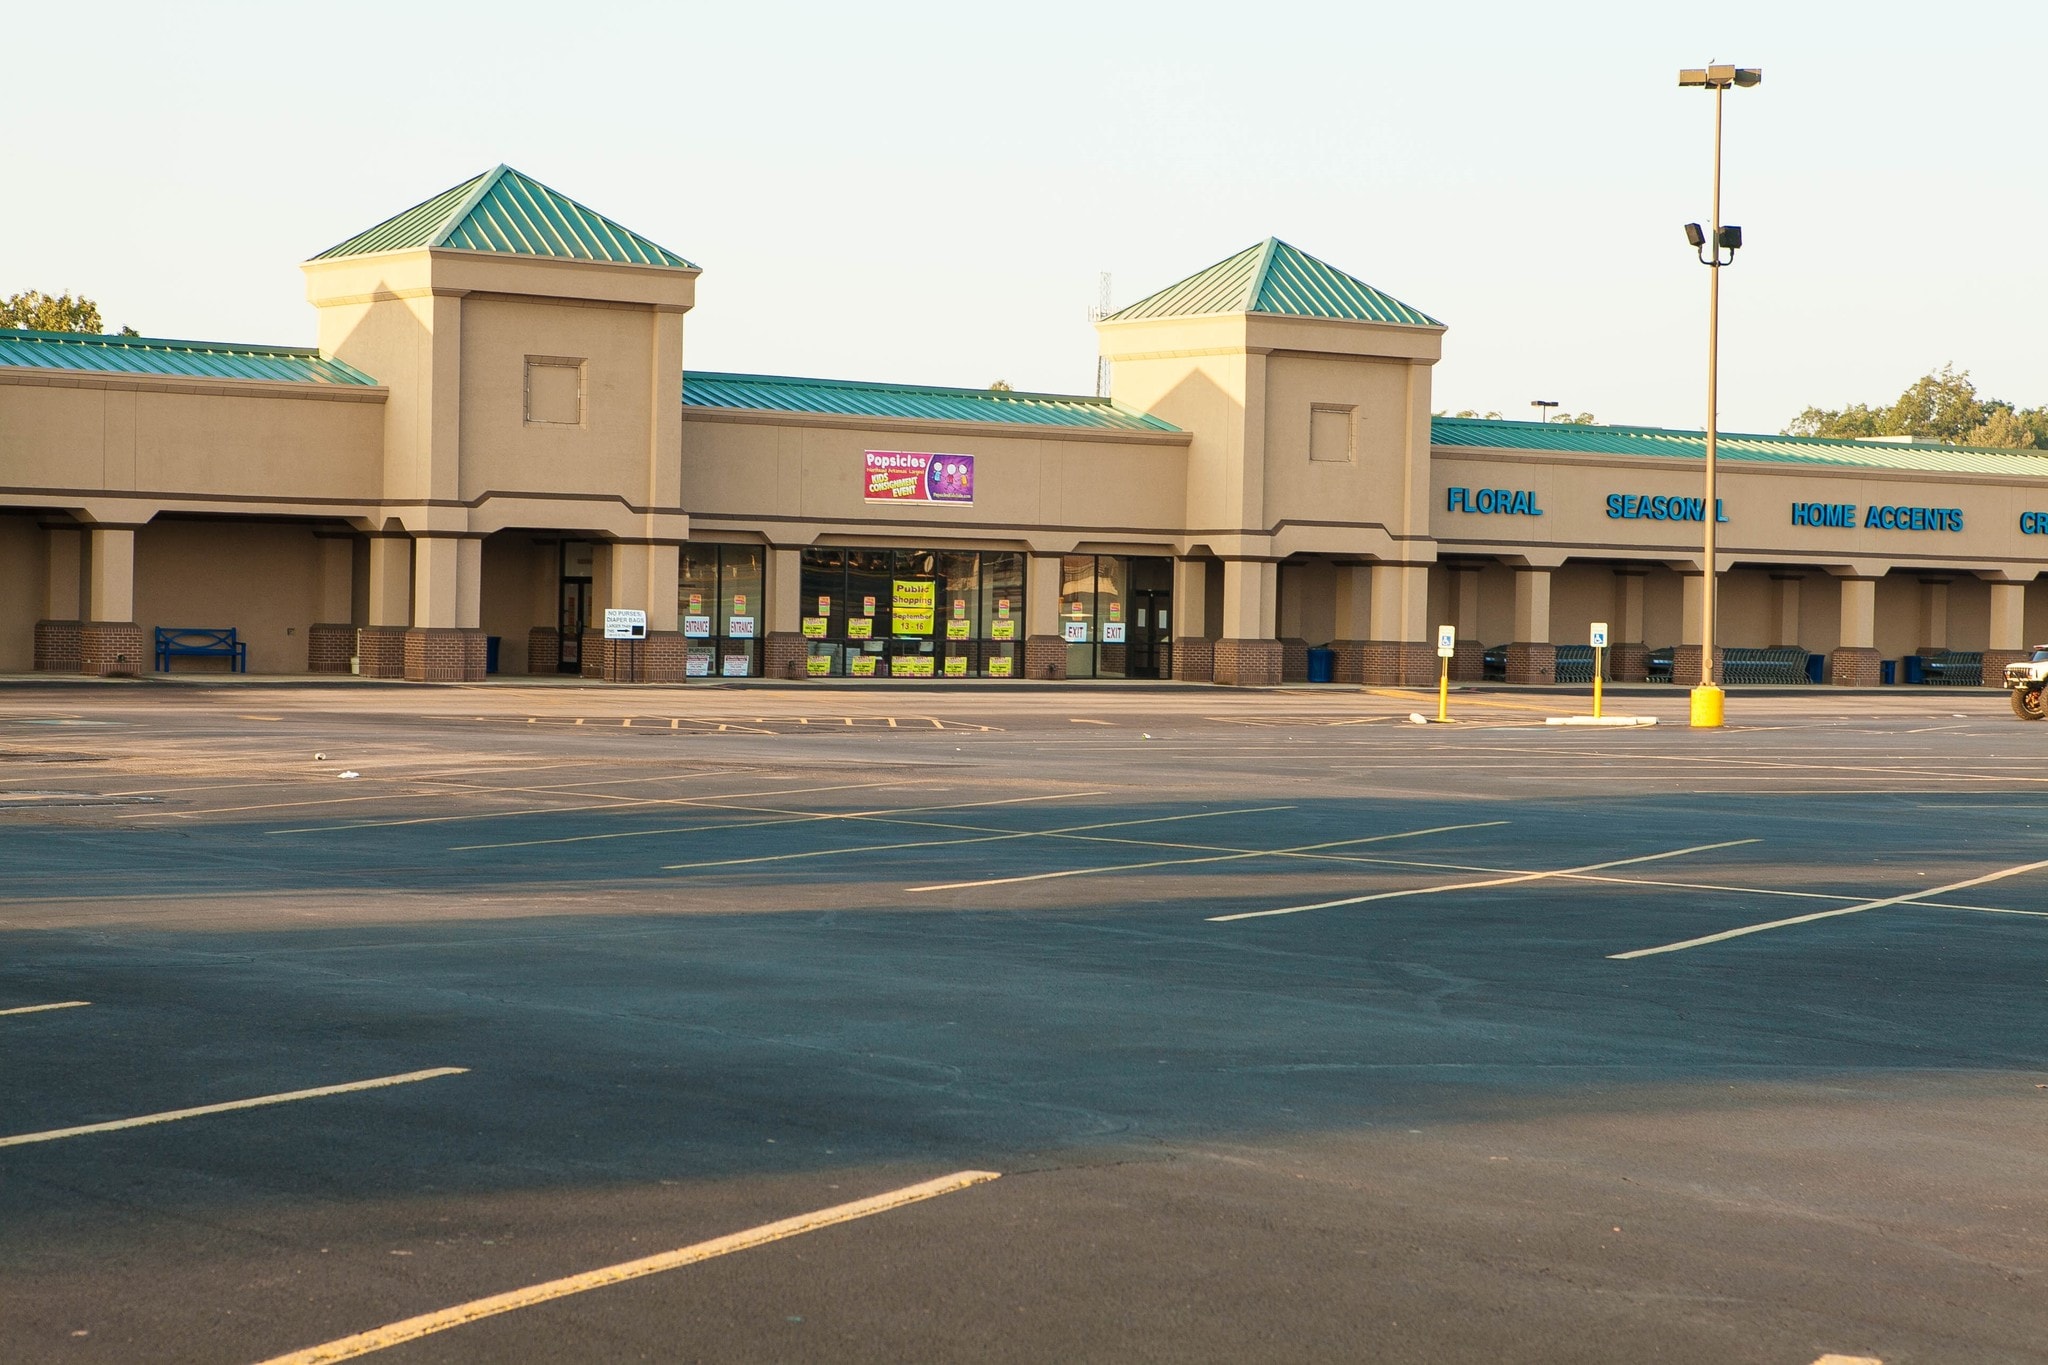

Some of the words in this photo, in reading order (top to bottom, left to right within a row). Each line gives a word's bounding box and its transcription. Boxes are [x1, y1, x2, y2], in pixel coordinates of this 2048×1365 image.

[866, 454, 926, 468] Popsicles
[869, 476, 918, 493] CONSIGNMENT
[871, 472, 889, 484] KIDS
[892, 485, 917, 498] EVENT
[1448, 487, 1543, 515] FLORAL
[1792, 502, 1857, 528] HOME
[1864, 506, 1964, 532] ACCENTS
[2020, 511, 2048, 535] CR
[896, 584, 930, 593] Public
[892, 595, 933, 606] Shopping
[893, 612, 932, 620] September
[686, 620, 709, 633] ENTRANCE
[731, 621, 753, 634] ENTRANCE
[901, 622, 910, 630] 13
[1069, 626, 1084, 638] EXIT
[1106, 627, 1122, 639] EXIT
